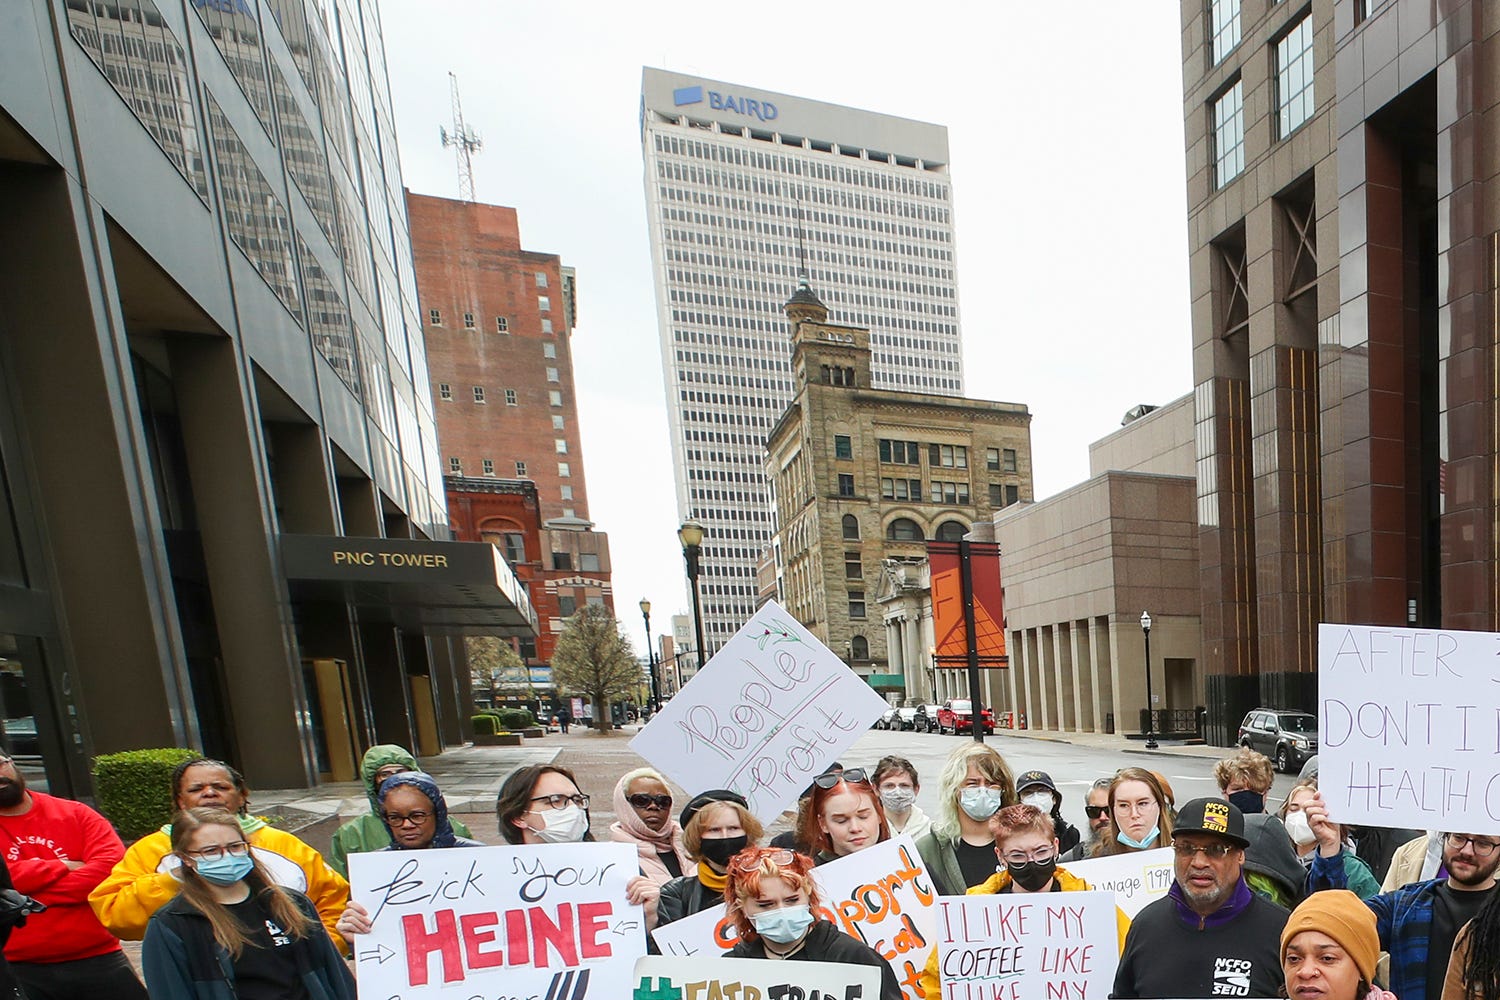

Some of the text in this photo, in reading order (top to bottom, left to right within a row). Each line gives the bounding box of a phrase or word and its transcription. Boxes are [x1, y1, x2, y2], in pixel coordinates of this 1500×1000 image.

[708, 91, 778, 121] BAIRD
[334, 552, 448, 568] PNC TOWER
[1330, 629, 1462, 678] AFTER
[675, 650, 815, 760] People
[1324, 699, 1442, 748] DON'T
[1455, 706, 1477, 752] I
[1347, 761, 1470, 817] HEALTH
[1205, 803, 1229, 812] NCFO
[1202, 822, 1227, 833] SEIU
[940, 903, 1085, 943] I LIKE MY
[402, 901, 613, 987] HEINE
[943, 945, 1094, 977] COFFEE LIKE
[1215, 958, 1252, 970] NCFO
[1047, 980, 1088, 1000] MY
[1212, 985, 1249, 996] SEIU
